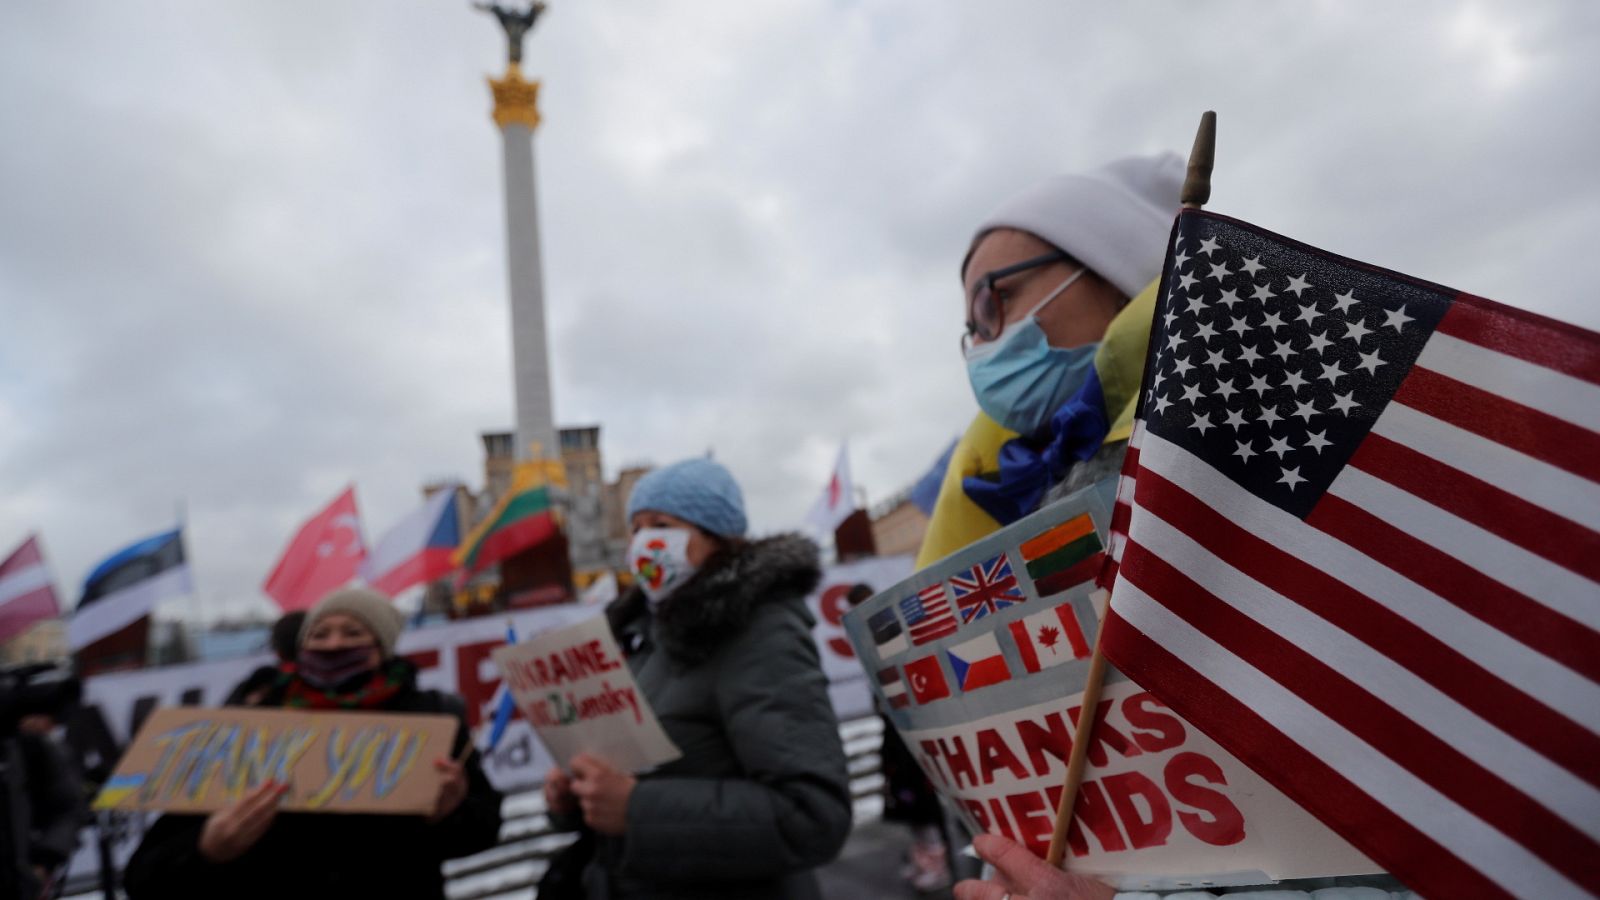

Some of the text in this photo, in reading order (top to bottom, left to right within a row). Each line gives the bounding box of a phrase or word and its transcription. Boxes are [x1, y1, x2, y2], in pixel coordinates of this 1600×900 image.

[140, 719, 429, 808] THANK YOU
[919, 692, 1187, 791] THANKS
